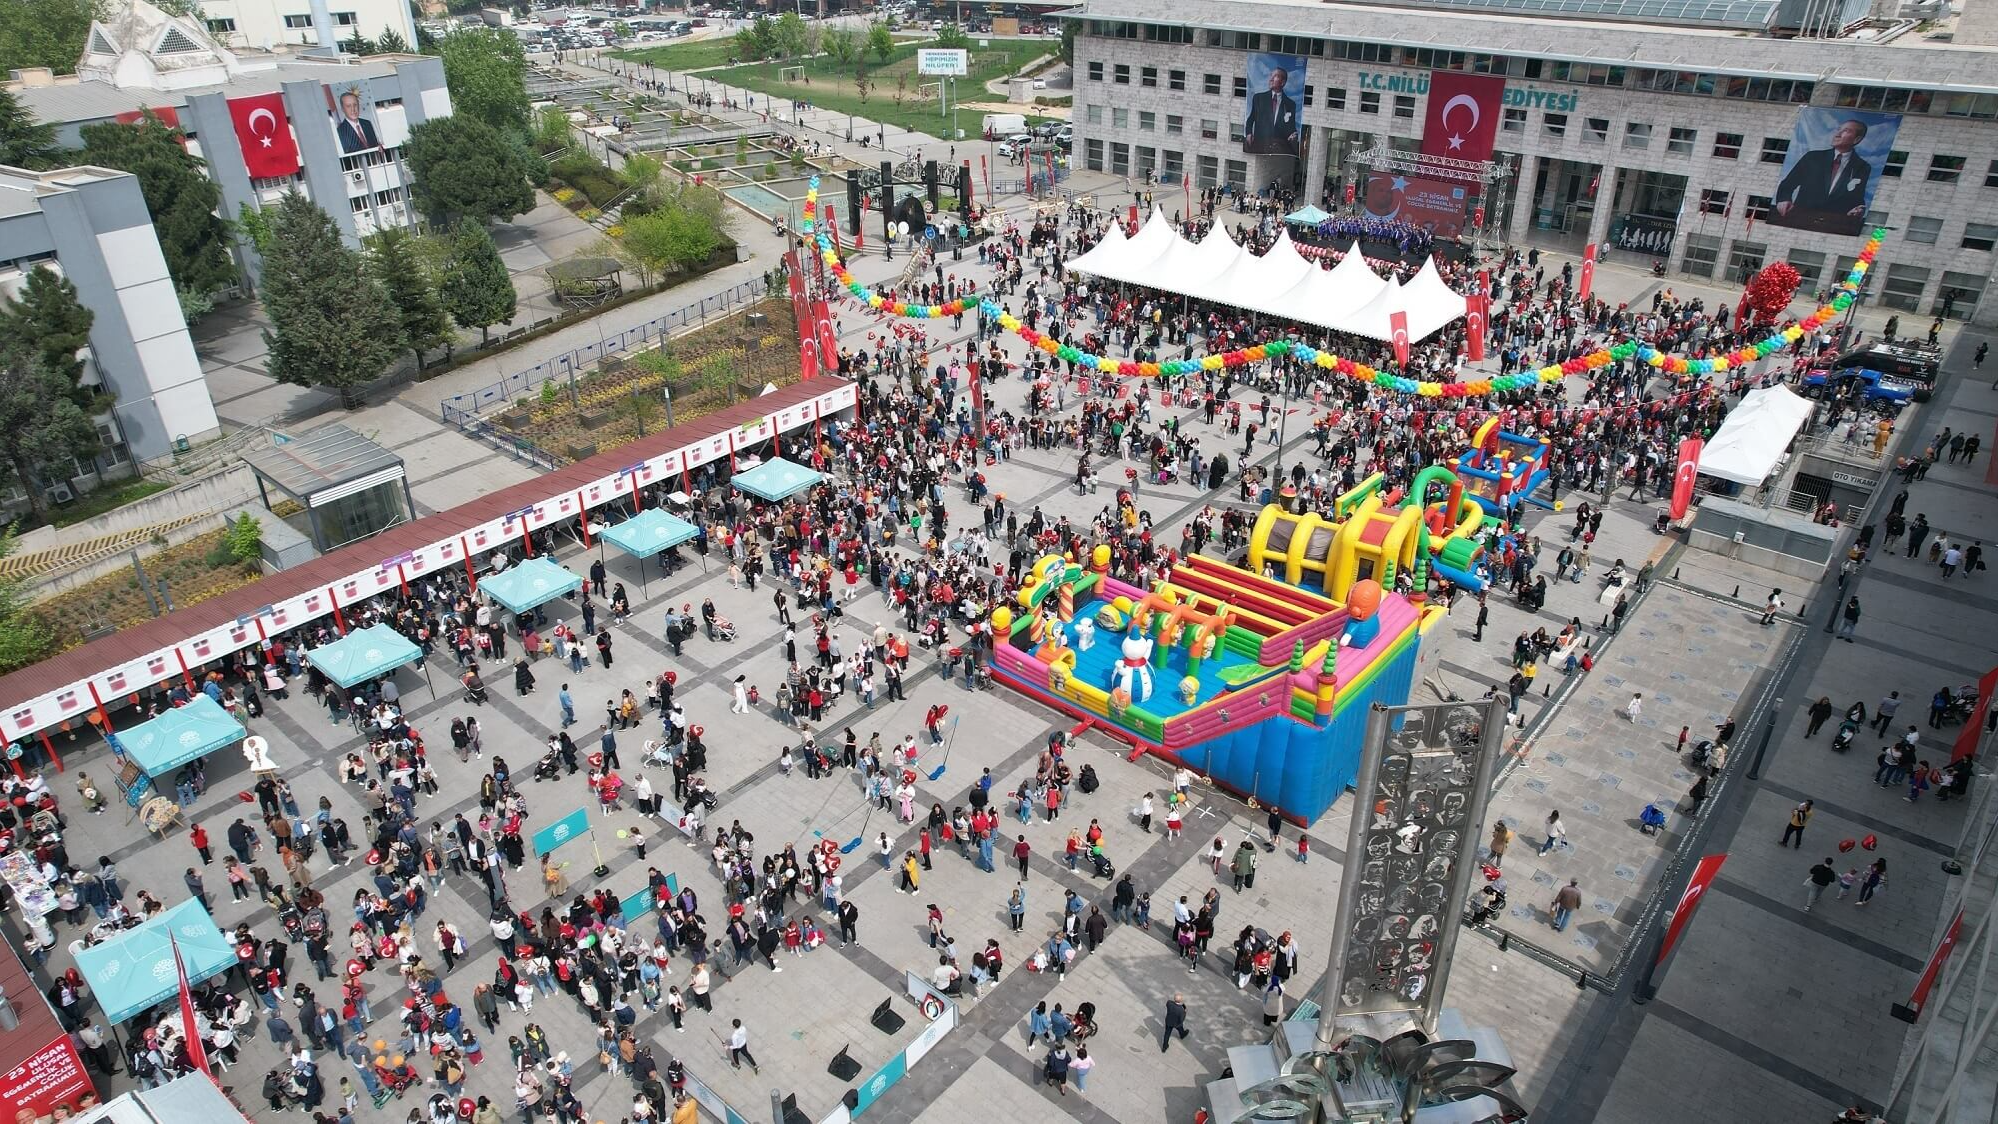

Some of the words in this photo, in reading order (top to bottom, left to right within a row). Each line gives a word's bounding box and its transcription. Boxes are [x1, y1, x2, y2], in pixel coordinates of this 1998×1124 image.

[1502, 84, 1579, 112] EDİYESİ
[1834, 472, 1848, 480] OTO
[2, 1065, 58, 1098] EGEMENLİK
[59, 1057, 72, 1066] VE
[8, 1066, 26, 1081] 23
[28, 1044, 66, 1069] NİSAN
[31, 1052, 69, 1075] ULUSAL
[16, 1068, 78, 1106] BAYRAMIMIZ
